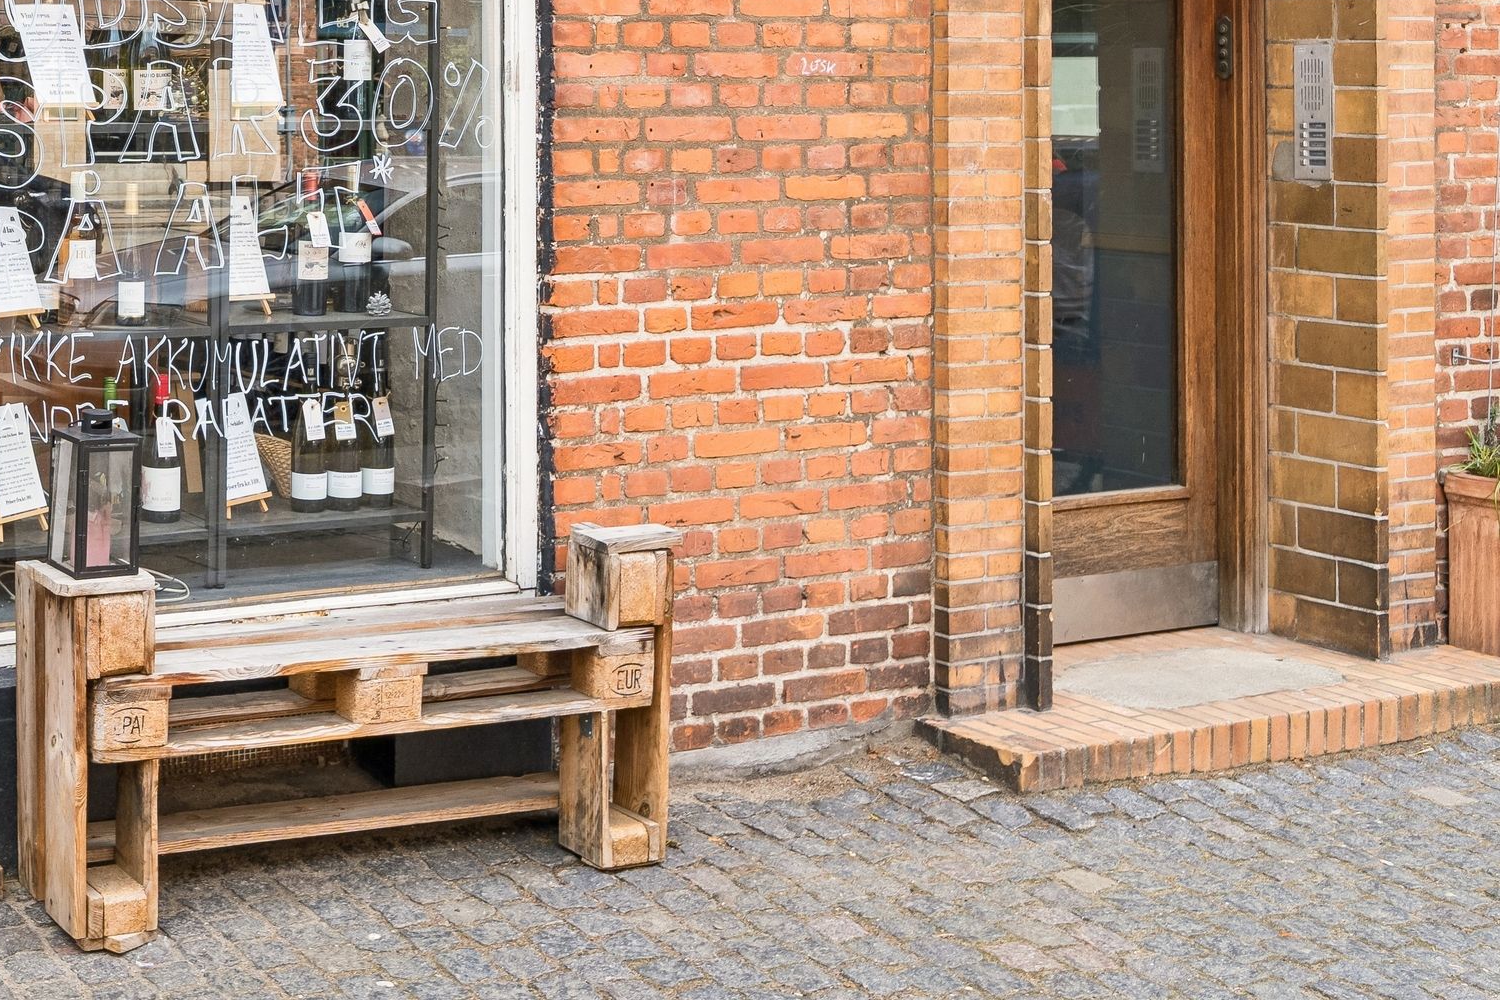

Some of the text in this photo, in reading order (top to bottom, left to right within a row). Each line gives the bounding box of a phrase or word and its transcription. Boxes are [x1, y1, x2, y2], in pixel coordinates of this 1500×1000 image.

[300, 57, 494, 151] 30%
[115, 329, 386, 395] AKKUMULATIVT
[413, 322, 484, 383] MED
[616, 668, 642, 690] EUR
